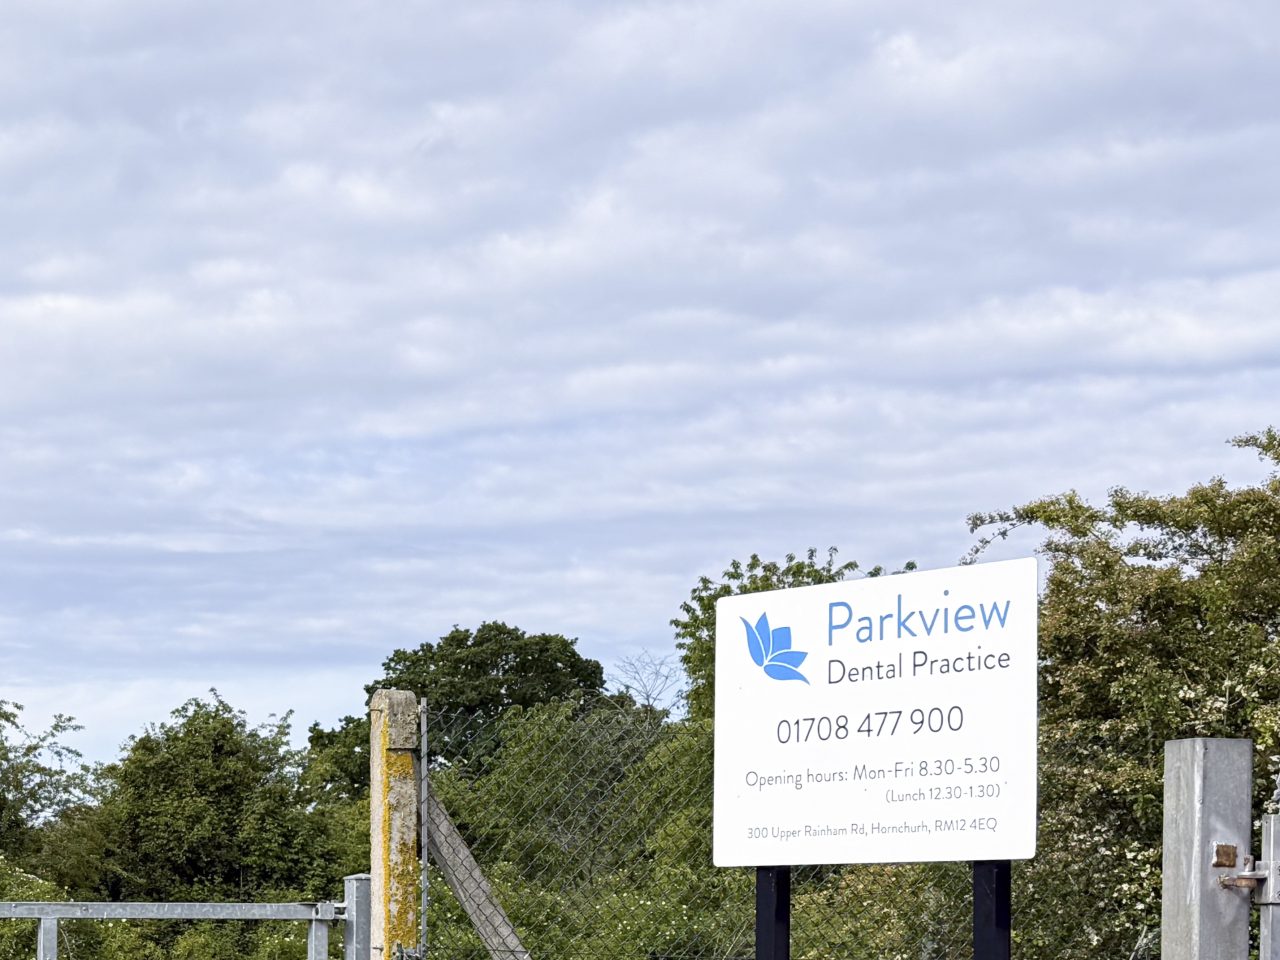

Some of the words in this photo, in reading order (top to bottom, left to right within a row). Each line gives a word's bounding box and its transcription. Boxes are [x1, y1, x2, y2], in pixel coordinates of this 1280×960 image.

[828, 589, 1011, 646] Parkview
[828, 652, 902, 684] Dental
[913, 645, 1011, 676] Practice
[777, 714, 849, 744] 01708
[857, 710, 903, 738] 477
[910, 705, 964, 735] 900
[745, 769, 803, 792] Opening
[806, 767, 848, 783] hours:
[853, 761, 914, 781] Mon-Fri
[918, 756, 1000, 777] 8.30-5.30
[885, 787, 926, 803] (Lunch
[928, 783, 1001, 800] 12.30-1.30)
[747, 827, 769, 839] 300
[771, 826, 802, 842] Upper
[804, 824, 848, 838] Rainham
[851, 823, 868, 837] Rd,
[935, 819, 967, 832] RM12
[969, 817, 998, 832] 4EQ
